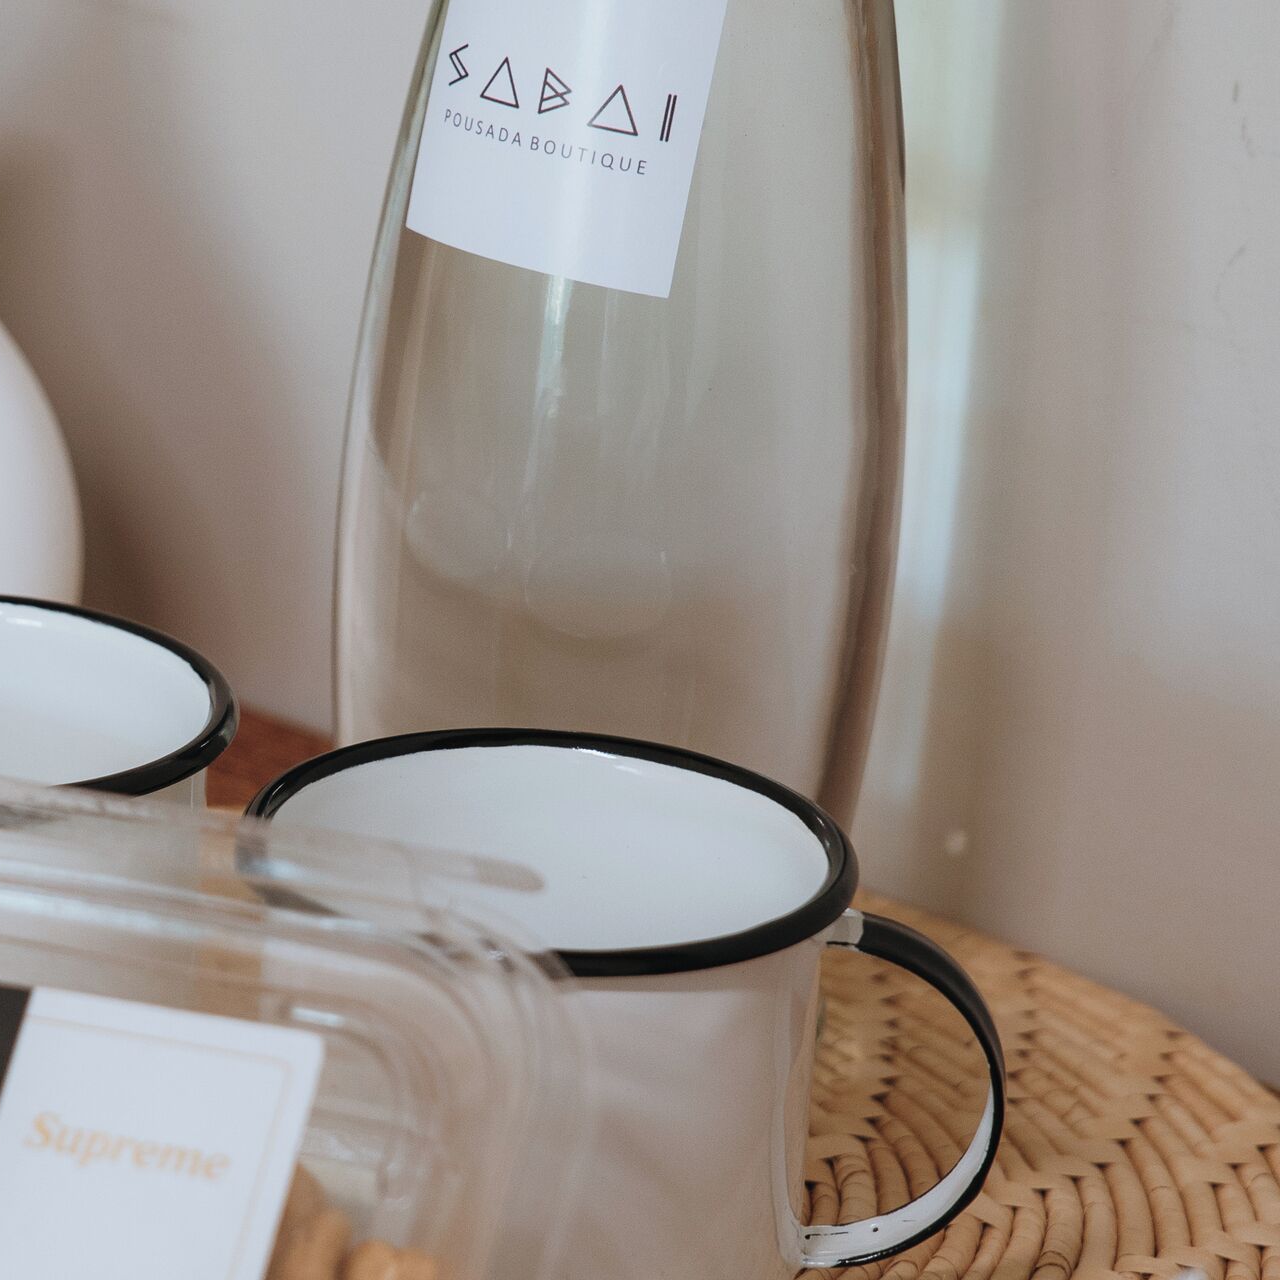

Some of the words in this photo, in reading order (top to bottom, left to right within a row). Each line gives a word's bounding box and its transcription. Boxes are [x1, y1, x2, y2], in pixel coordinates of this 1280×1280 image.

[448, 43, 678, 143] SABAI
[443, 108, 522, 147] POUSADA
[529, 135, 648, 176] BOUTIQUE
[24, 1111, 232, 1181] Supreme
